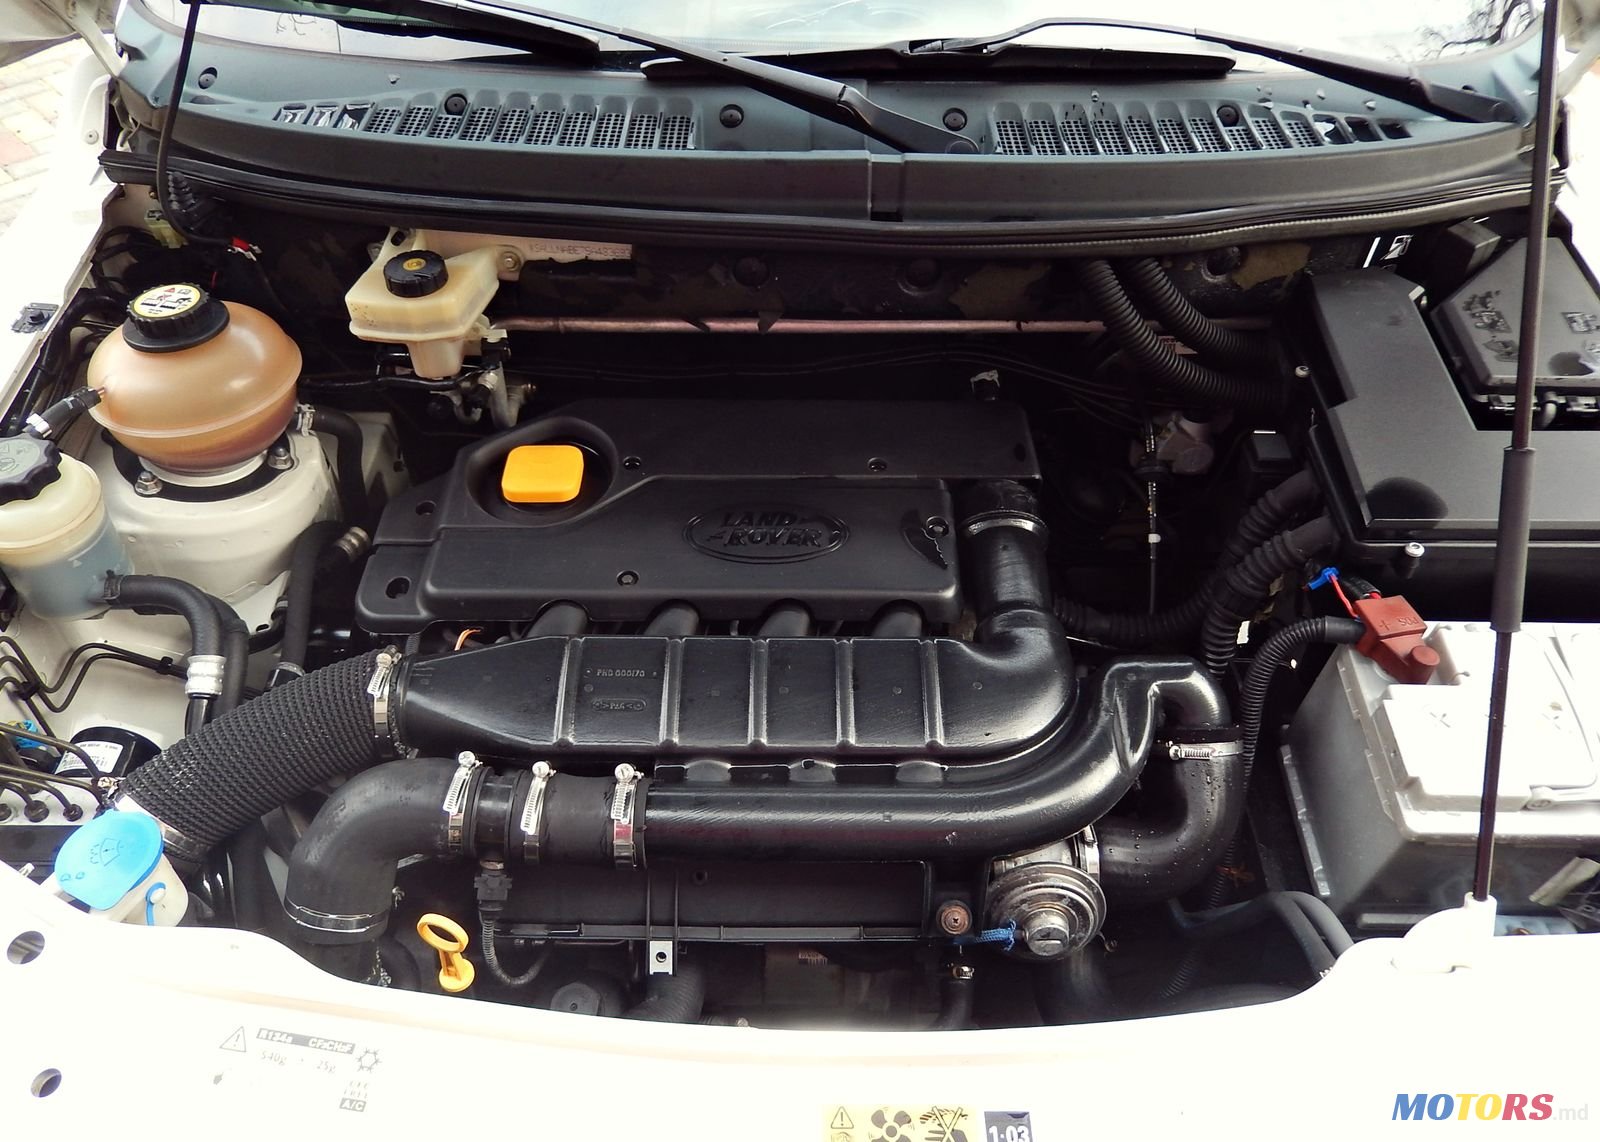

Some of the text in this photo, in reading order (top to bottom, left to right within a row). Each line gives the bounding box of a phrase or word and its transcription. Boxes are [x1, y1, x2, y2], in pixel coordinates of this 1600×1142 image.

[721, 511, 799, 527] LAND
[723, 528, 823, 547] ROVER
[341, 1099, 365, 1111] A/C
